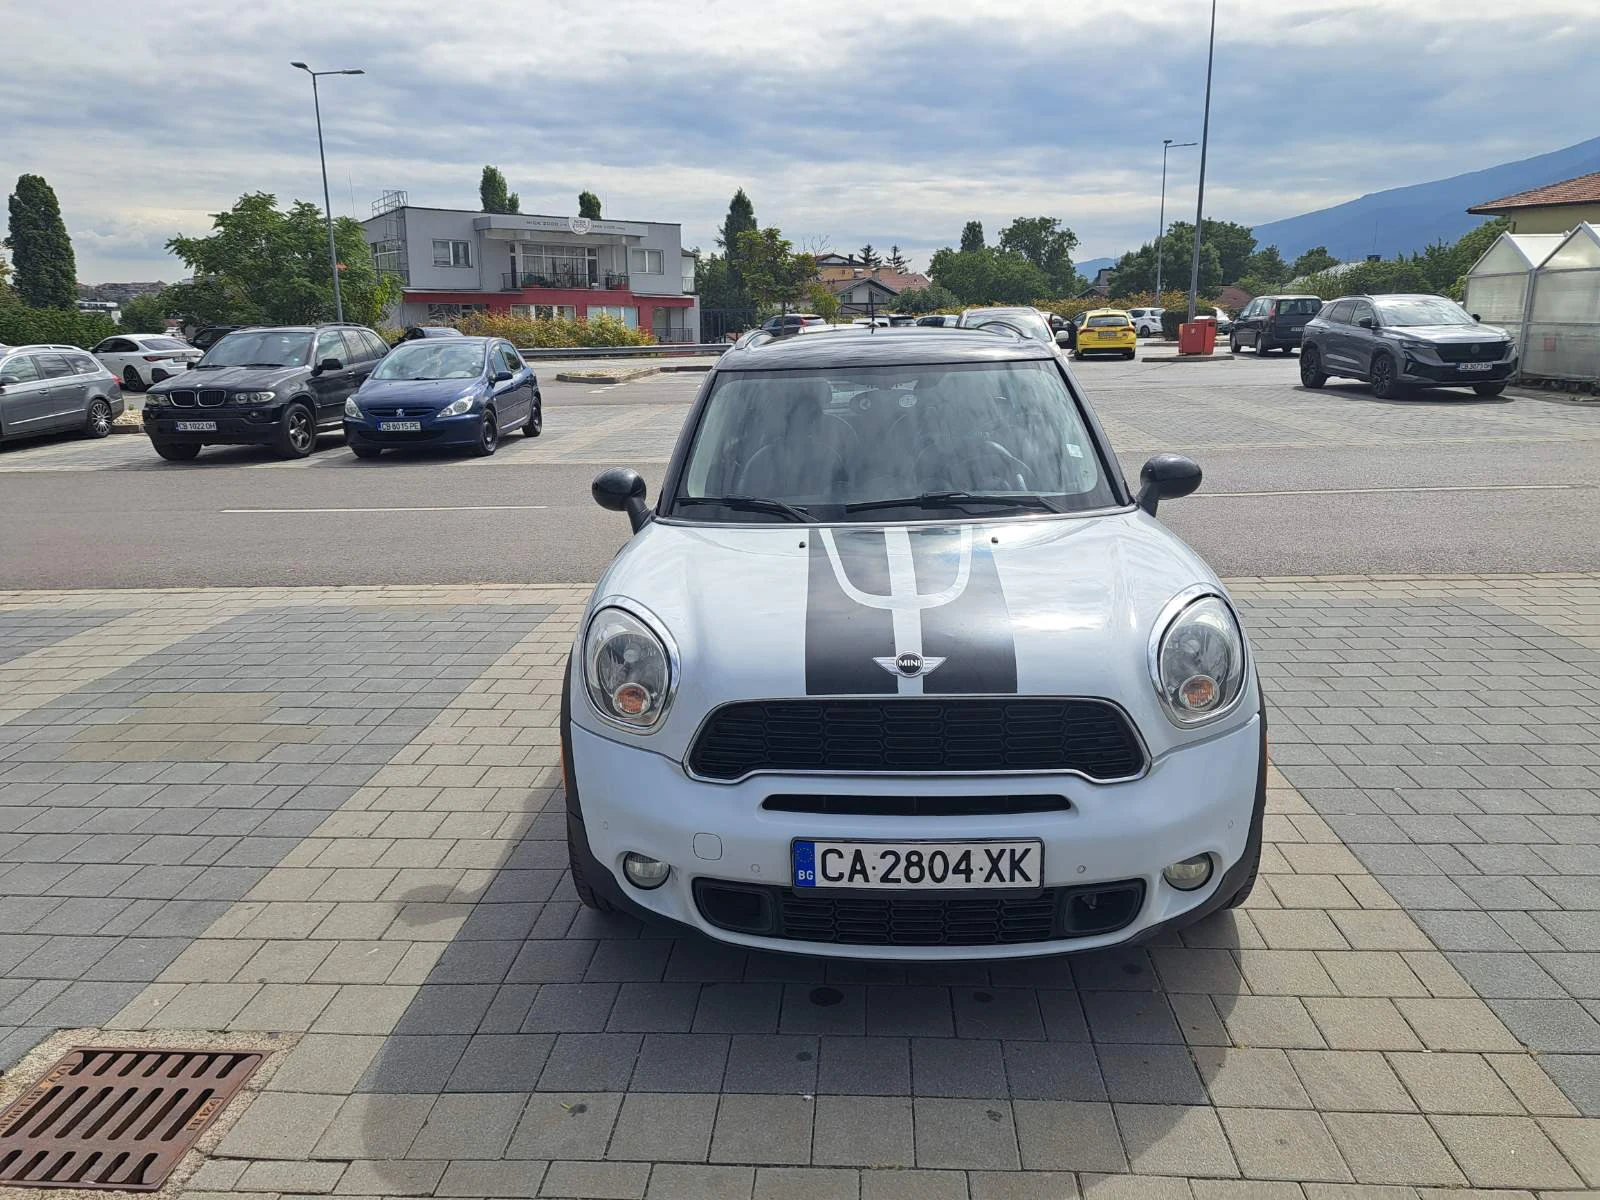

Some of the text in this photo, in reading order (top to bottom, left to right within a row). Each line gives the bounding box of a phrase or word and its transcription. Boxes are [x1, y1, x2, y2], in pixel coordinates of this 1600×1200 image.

[409, 422, 420, 430] PE
[898, 659, 923, 667] MINI
[797, 869, 814, 881] BG
